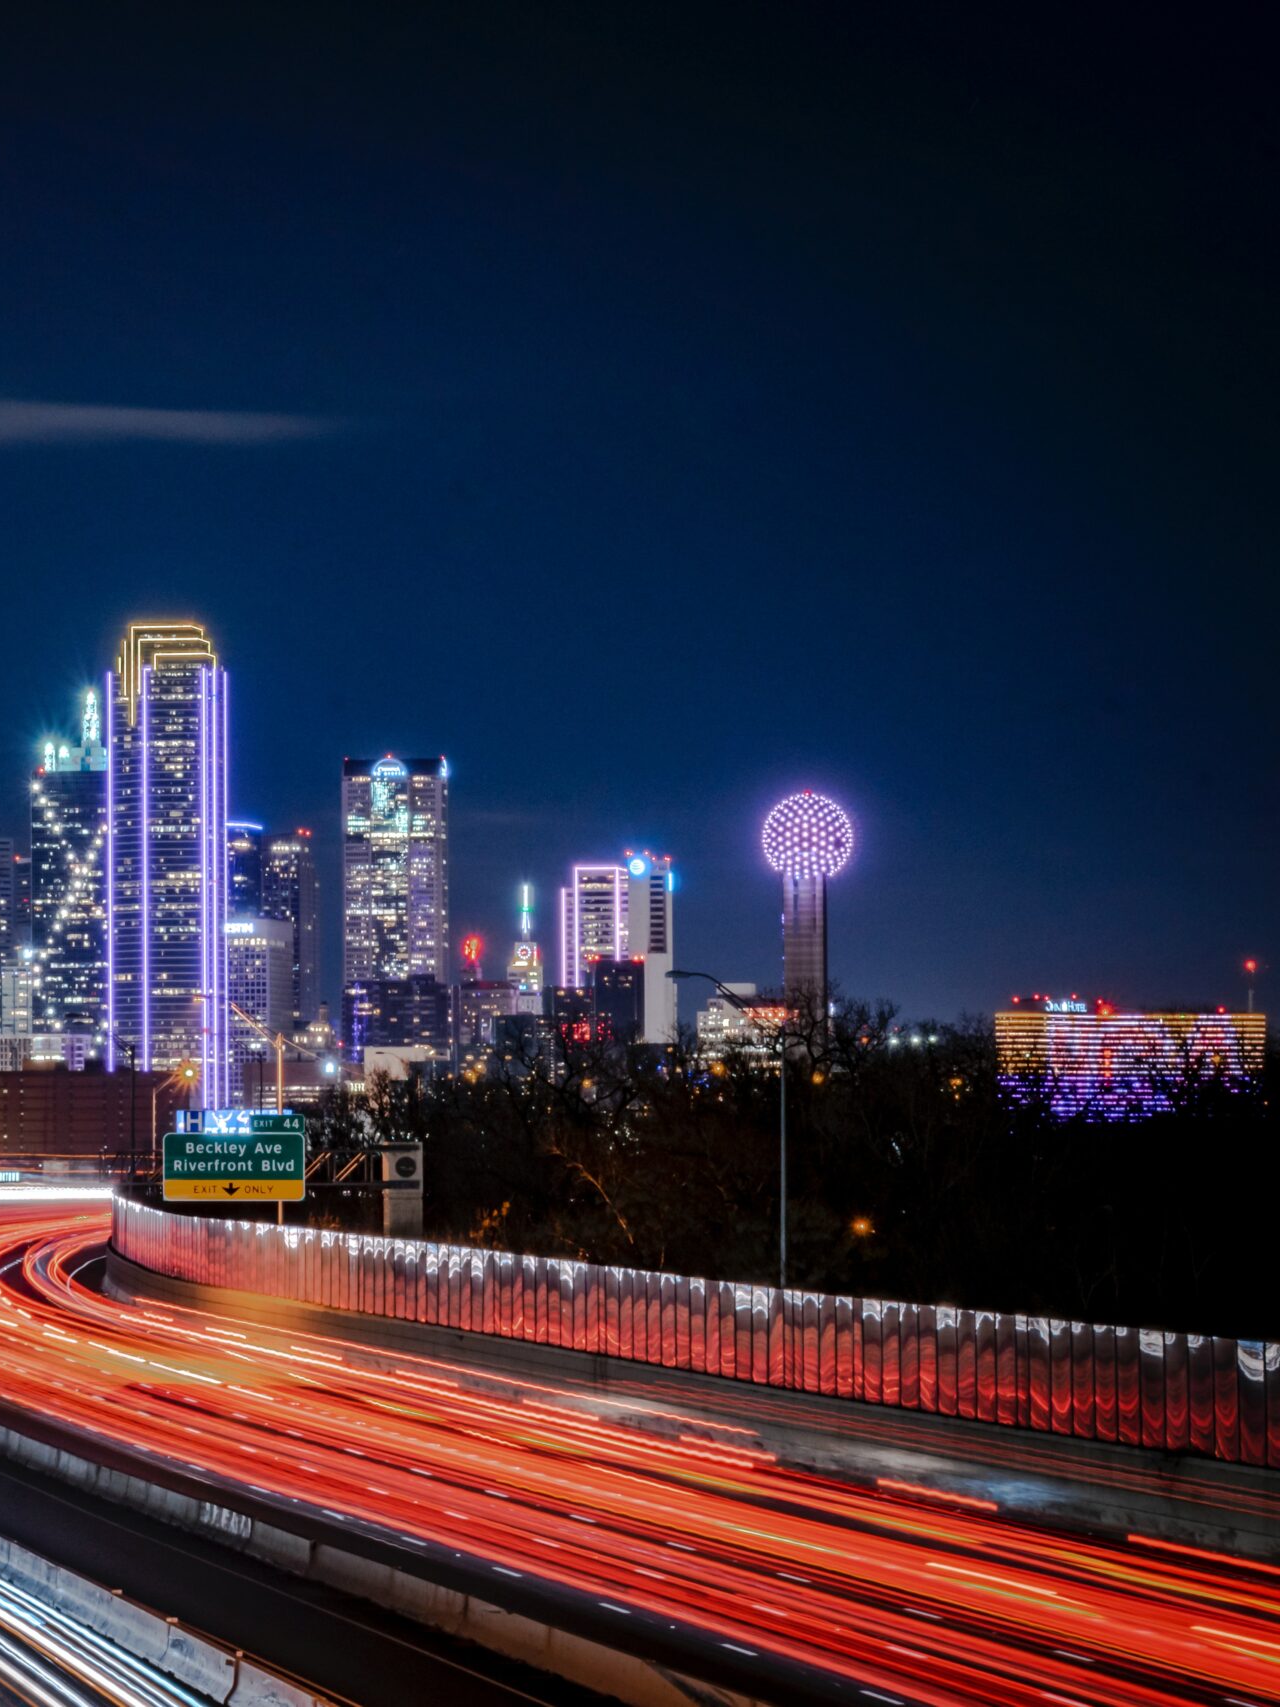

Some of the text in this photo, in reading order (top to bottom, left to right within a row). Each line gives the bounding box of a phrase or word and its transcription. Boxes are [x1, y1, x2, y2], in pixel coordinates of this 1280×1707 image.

[186, 1111, 202, 1132] H
[283, 1118, 300, 1129] 44
[185, 1142, 282, 1157] Beckley Ave
[173, 1159, 295, 1172] Riverfront Blvd
[193, 1185, 274, 1194] EXIT ONLY
